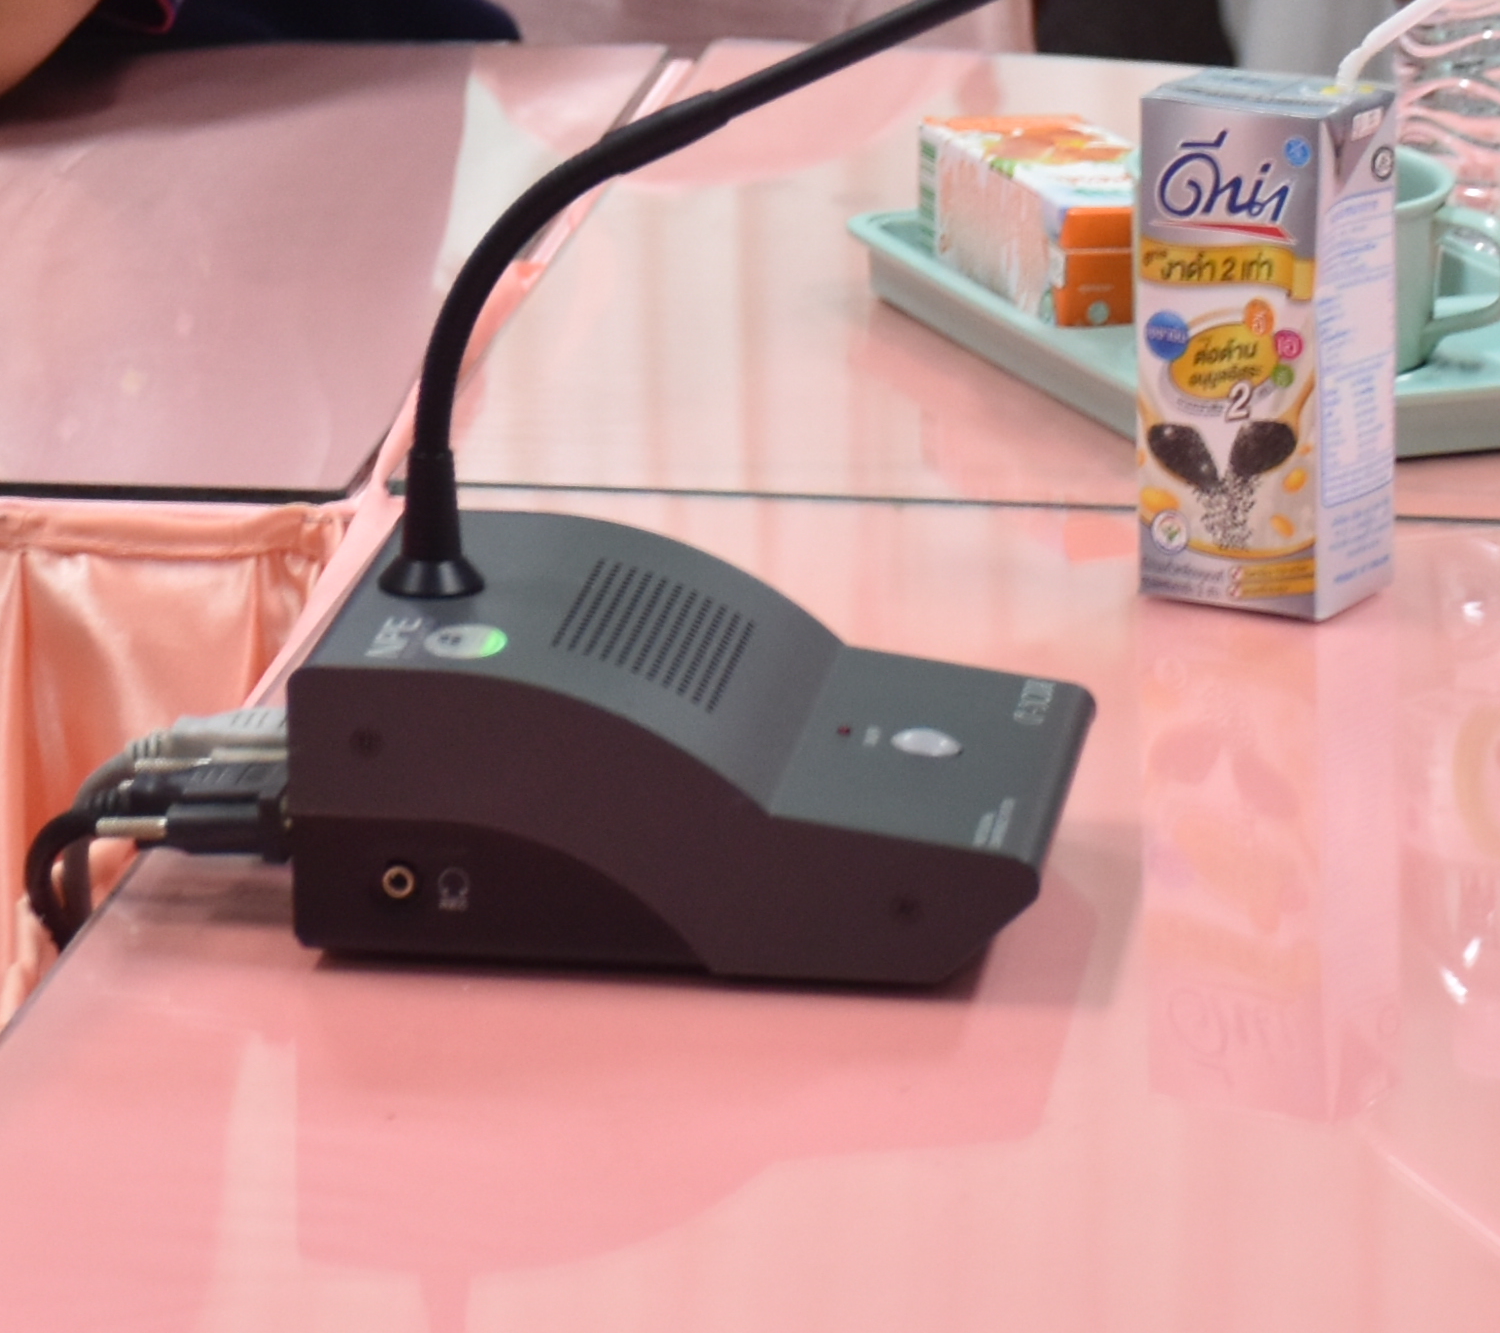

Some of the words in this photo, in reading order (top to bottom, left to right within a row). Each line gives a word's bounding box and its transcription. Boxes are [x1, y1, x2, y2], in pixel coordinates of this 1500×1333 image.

[1158, 130, 1289, 221] ดีน่า
[1161, 251, 1216, 281] งาดำ
[1220, 256, 1236, 282] 2
[1225, 381, 1252, 423] 2
